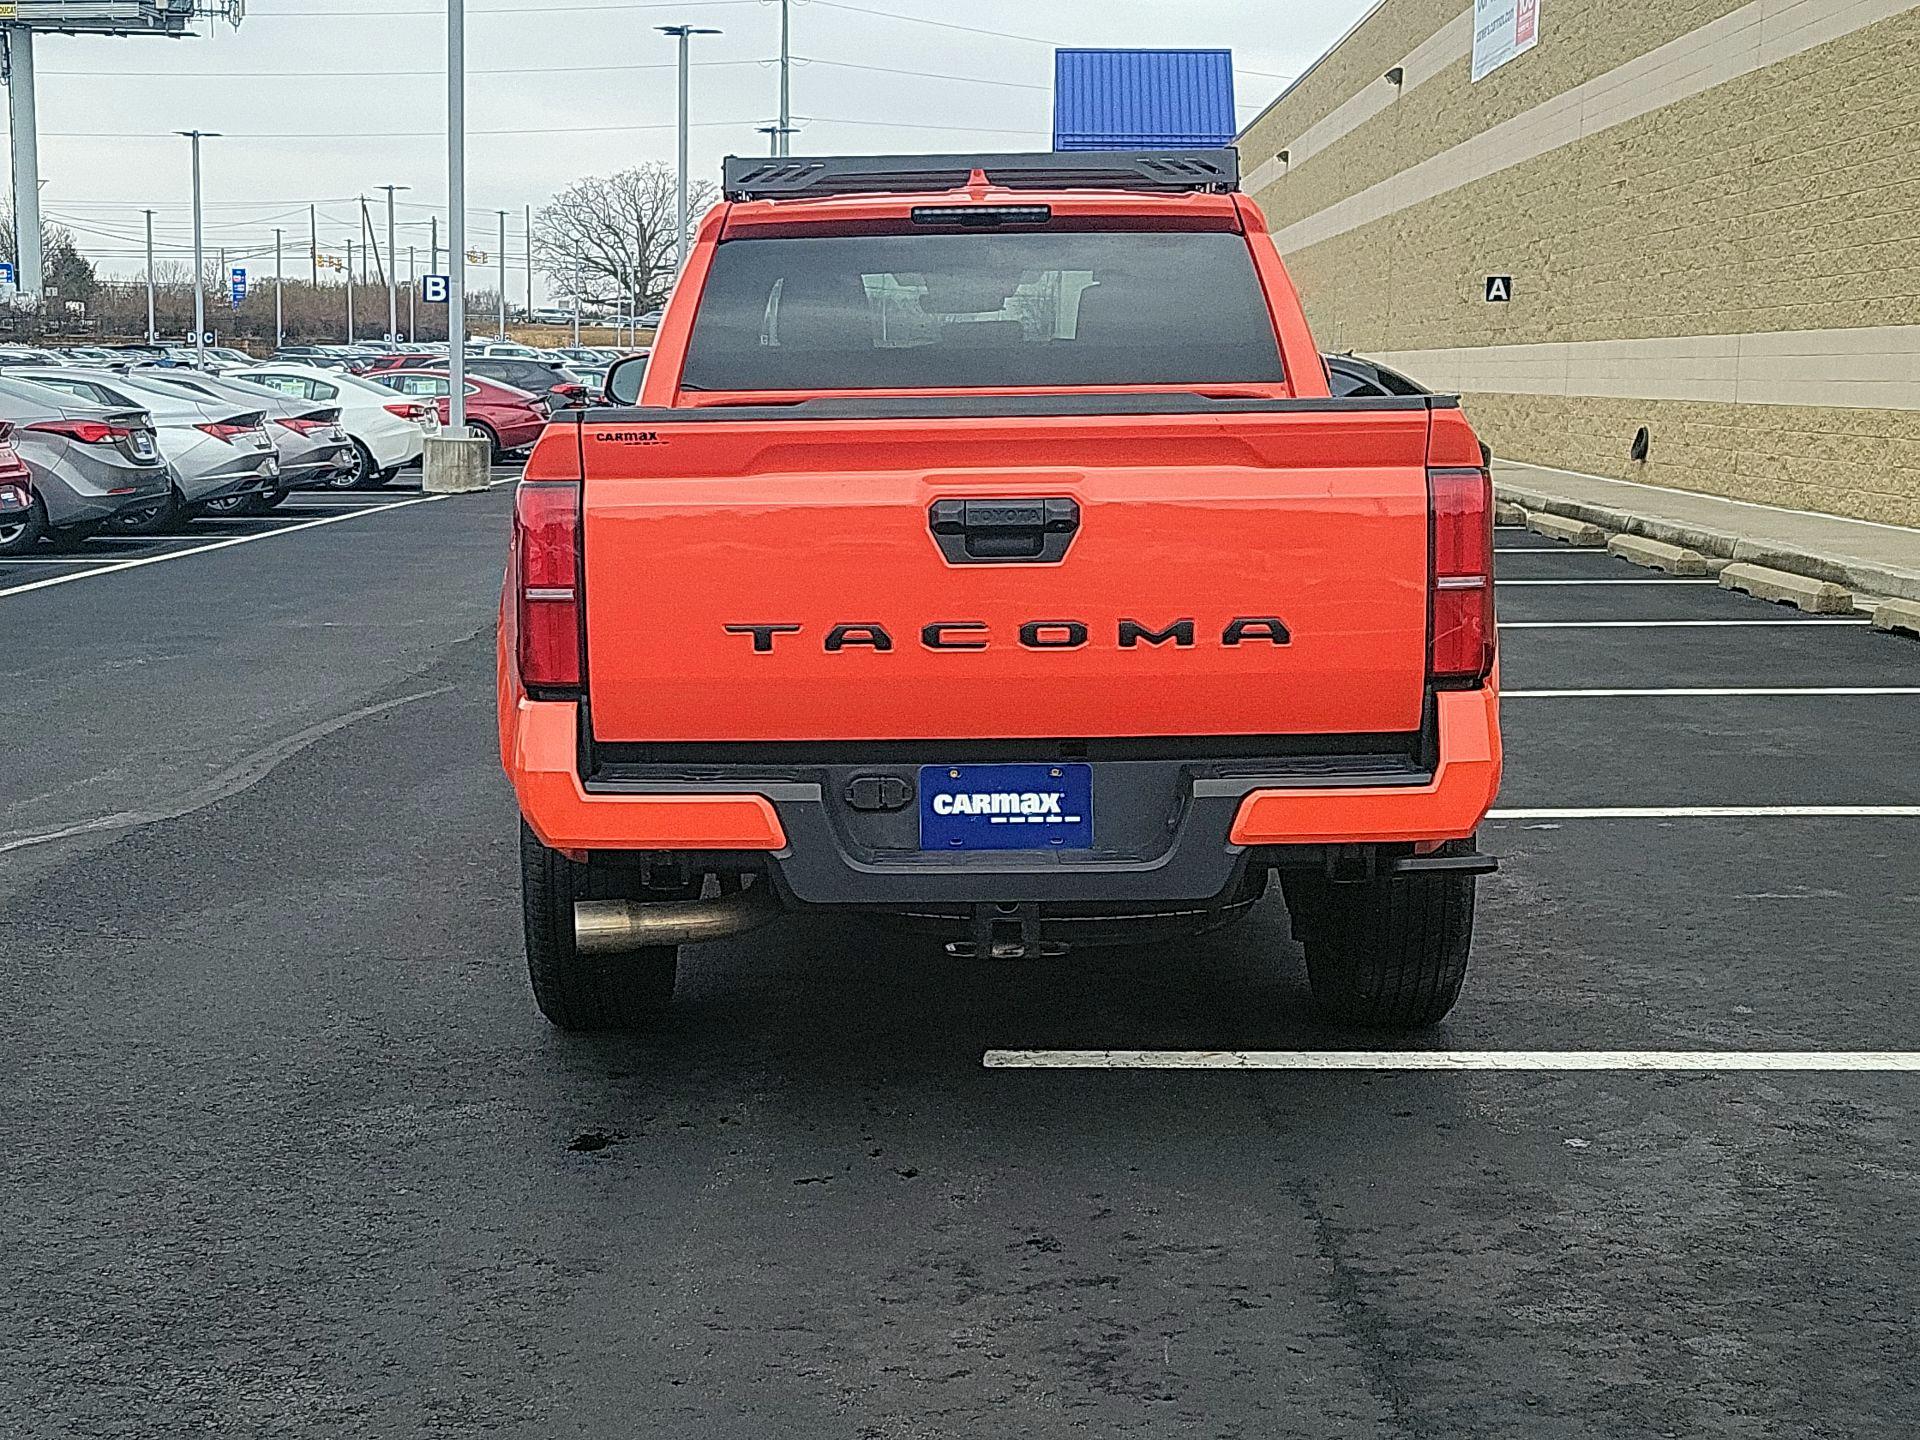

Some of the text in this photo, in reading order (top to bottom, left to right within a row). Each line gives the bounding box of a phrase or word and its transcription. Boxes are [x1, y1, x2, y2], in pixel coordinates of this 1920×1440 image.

[426, 277, 447, 301] B
[1488, 278, 1508, 300] A
[154, 331, 160, 339] E
[187, 332, 196, 343] D
[203, 332, 213, 343] C
[383, 333, 391, 342] D
[396, 333, 404, 342] C
[968, 509, 1041, 524] TOYOTA
[723, 616, 1292, 654] TACOMA
